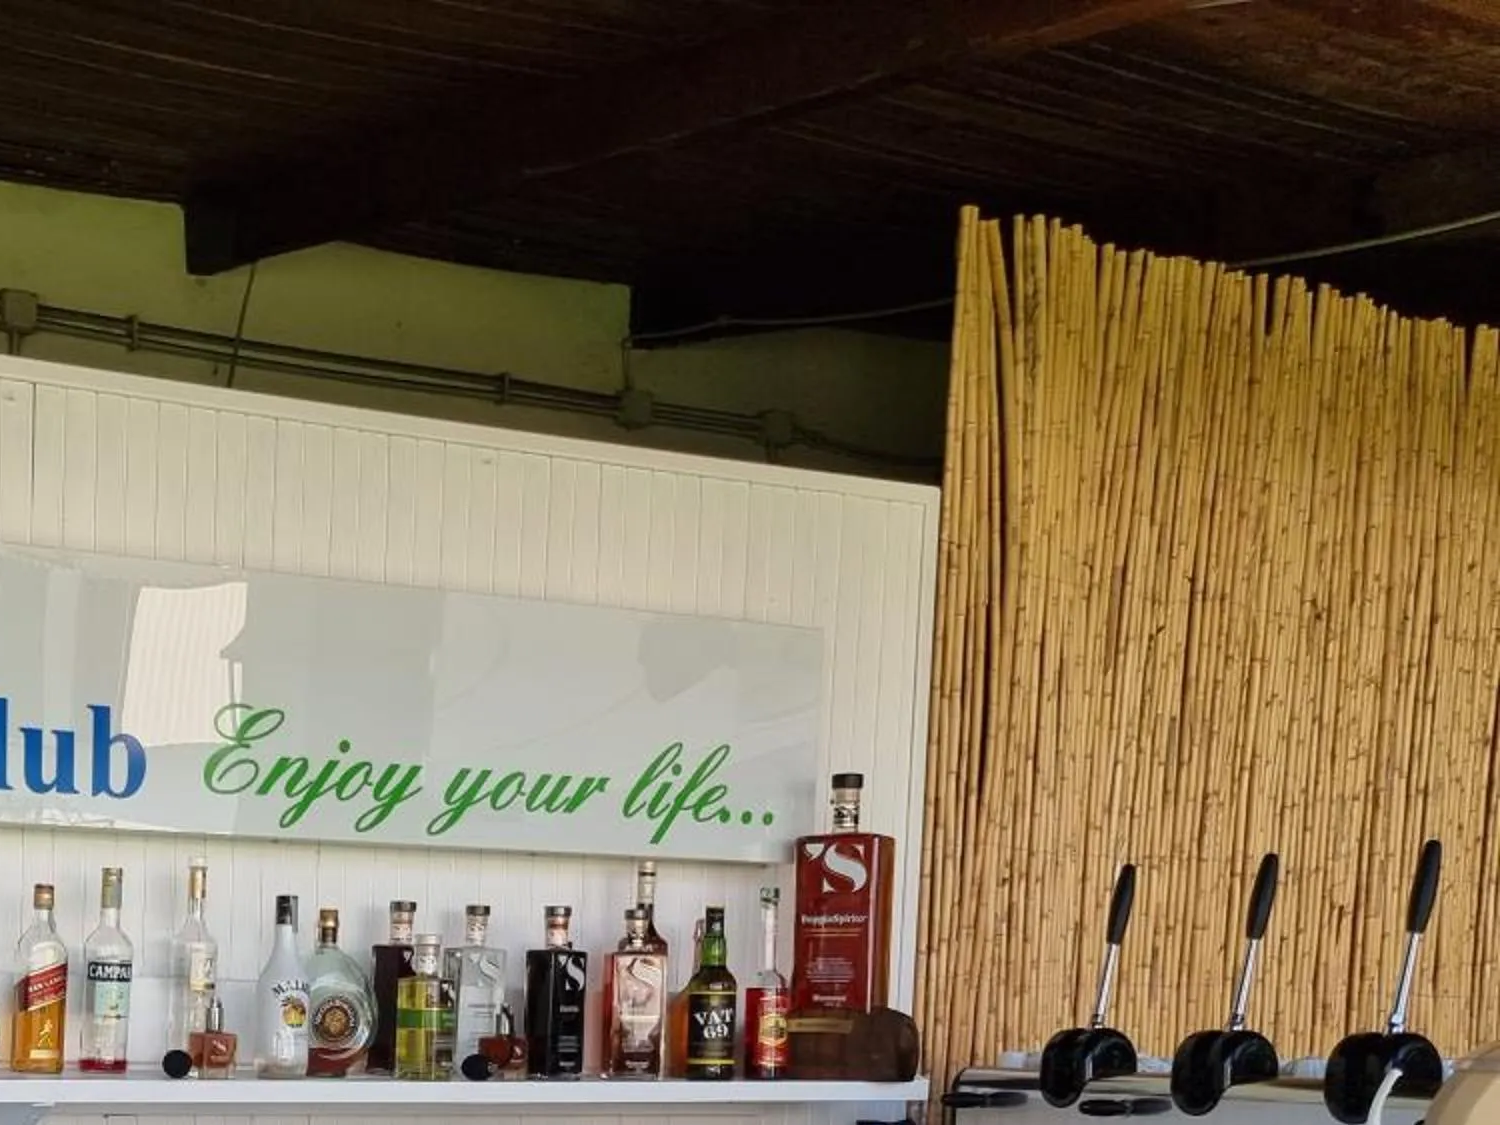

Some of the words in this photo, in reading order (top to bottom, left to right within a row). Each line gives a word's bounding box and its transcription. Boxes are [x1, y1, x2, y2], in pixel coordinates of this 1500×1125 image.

[203, 702, 422, 833] Enjoy
[426, 757, 610, 836] your
[693, 1007, 734, 1025] VAT
[703, 1023, 729, 1039] 69
